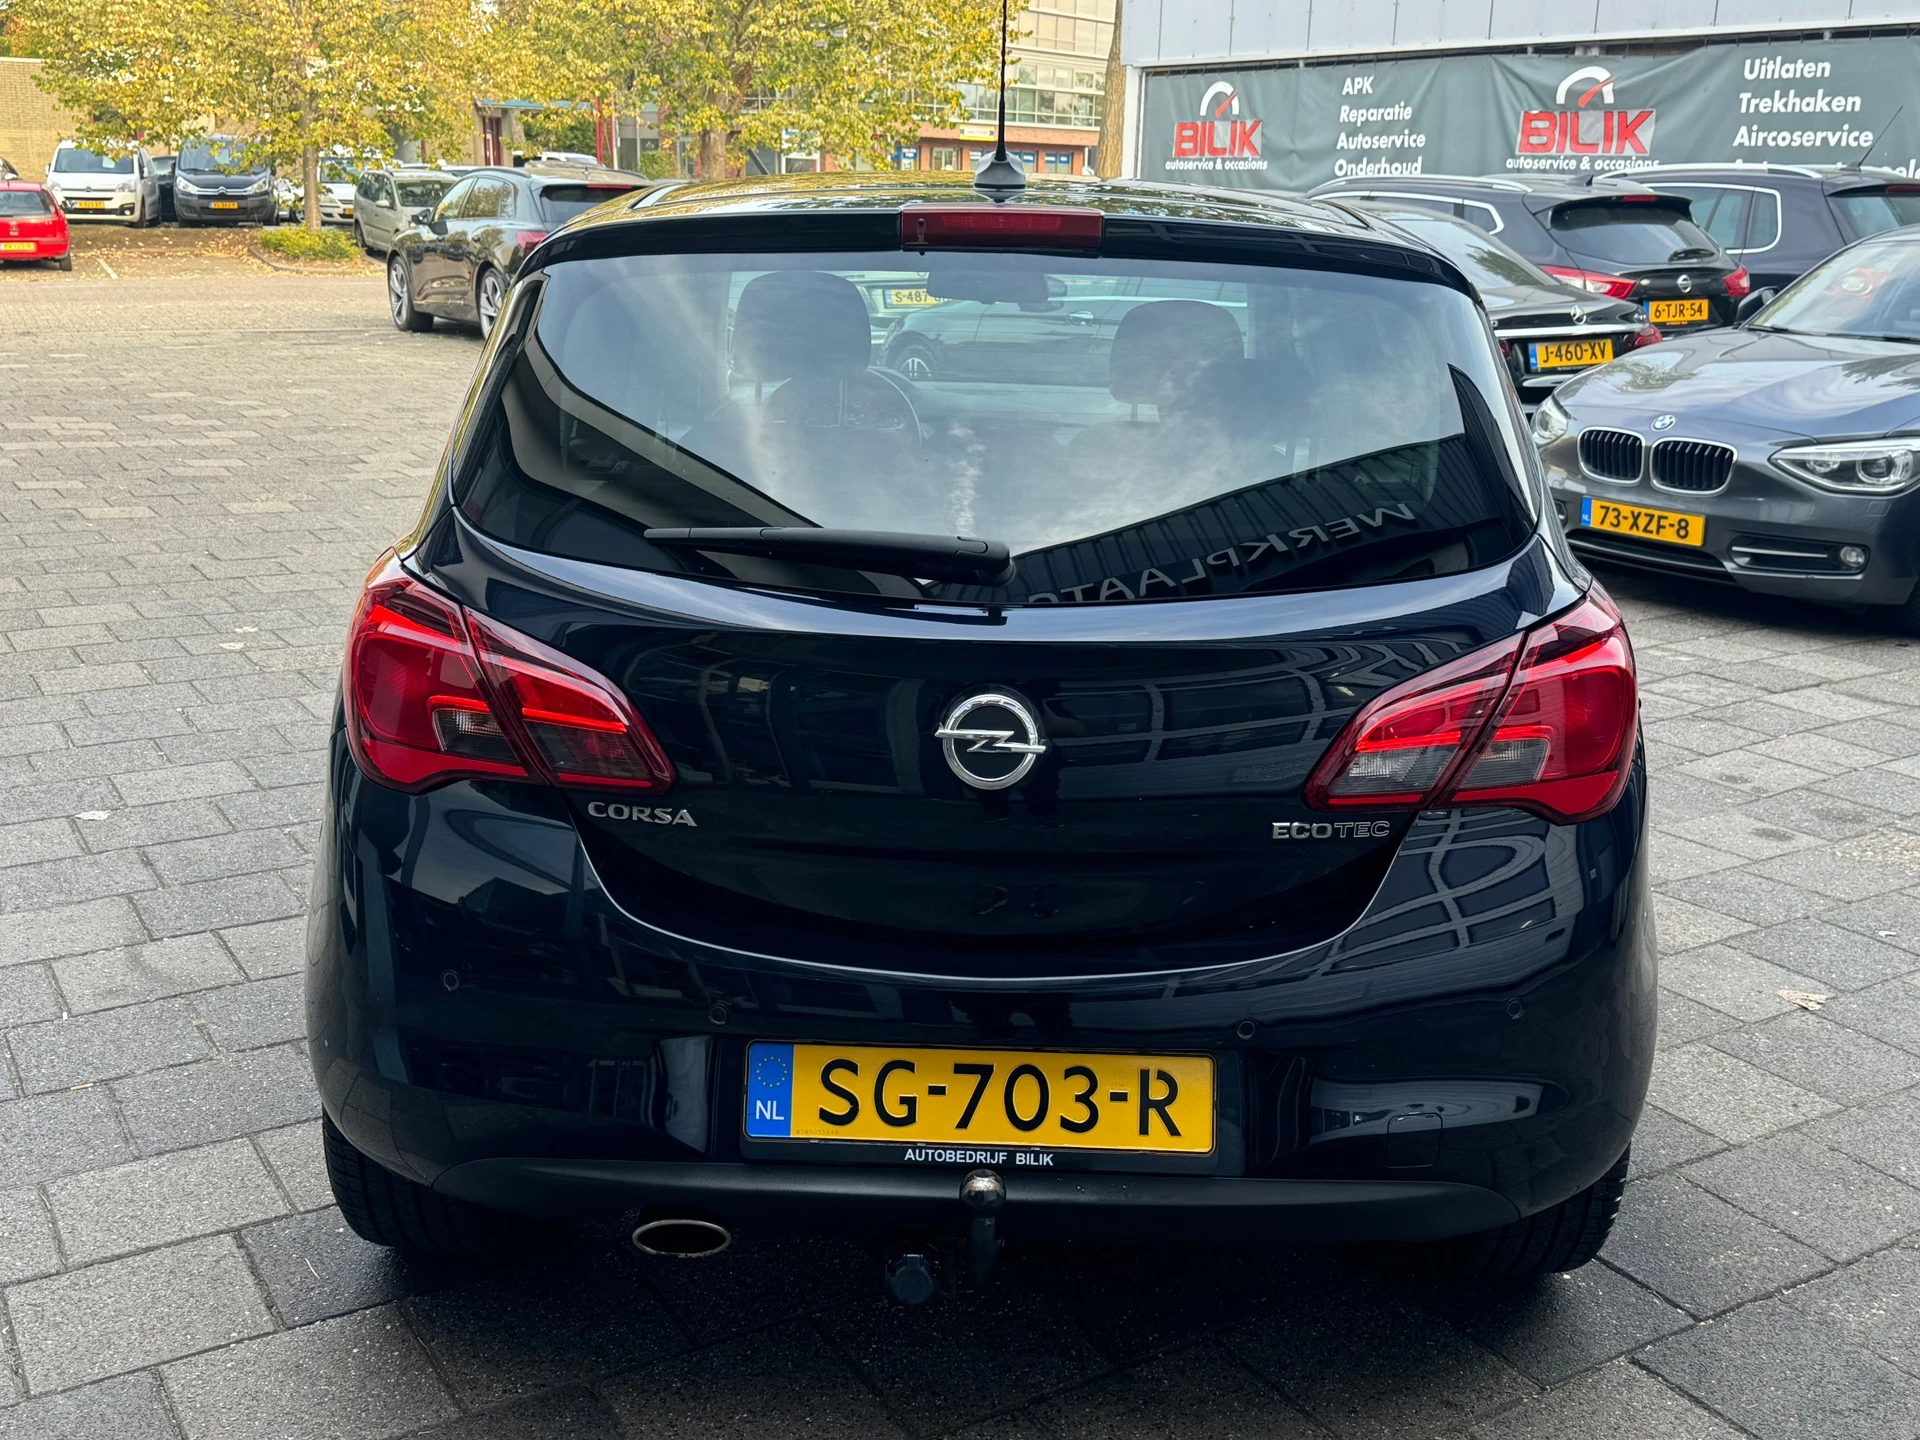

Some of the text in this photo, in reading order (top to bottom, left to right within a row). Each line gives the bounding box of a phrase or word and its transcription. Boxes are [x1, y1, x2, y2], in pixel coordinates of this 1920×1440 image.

[1743, 56, 1831, 80] Uitlaten
[1342, 76, 1375, 96] APK
[1739, 89, 1861, 113] Trekhaken
[1339, 101, 1412, 126] Reparatie
[1173, 120, 1262, 157] BILIK
[1336, 131, 1426, 150] Autoservice
[1518, 110, 1654, 155] BILIK
[1732, 123, 1874, 148] Aircoservice
[1165, 157, 1268, 171] autoservice & occasions
[1334, 156, 1422, 177] Onderhoud
[1505, 155, 1577, 170] autoservice
[1579, 157, 1591, 170] &
[1654, 302, 1703, 319] 6-TJR-54
[1542, 342, 1607, 364] J-460-XV
[1599, 505, 1690, 539] 73-XZF-8
[587, 801, 698, 827] CORSA
[1271, 820, 1391, 840] ECOTEC
[817, 1058, 1183, 1137] SG-703-R
[754, 1100, 785, 1121] NL
[904, 1149, 1054, 1166] AUTOBEDRIJF BILIK
